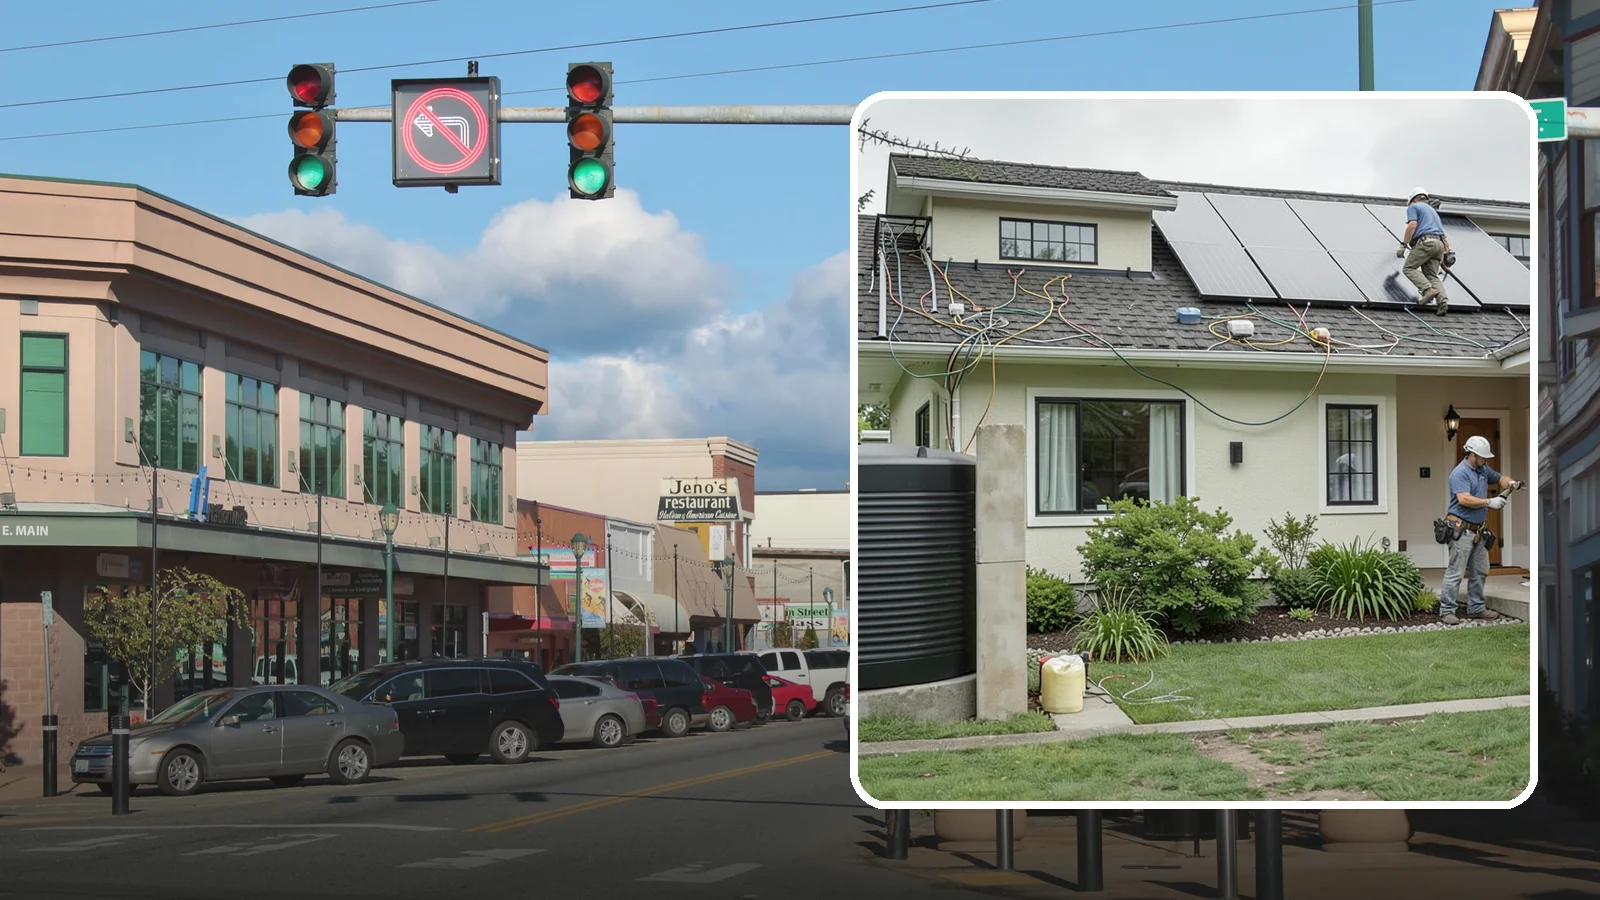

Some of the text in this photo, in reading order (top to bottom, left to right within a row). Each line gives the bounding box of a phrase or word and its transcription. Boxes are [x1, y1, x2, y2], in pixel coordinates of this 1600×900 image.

[670, 480, 727, 495] Jeno's
[665, 497, 731, 509] restaurant
[659, 510, 681, 519] Italian
[686, 509, 714, 519] American
[715, 509, 738, 519] Cuisine
[2, 525, 49, 536] E. MAIN
[797, 607, 828, 617] Street
